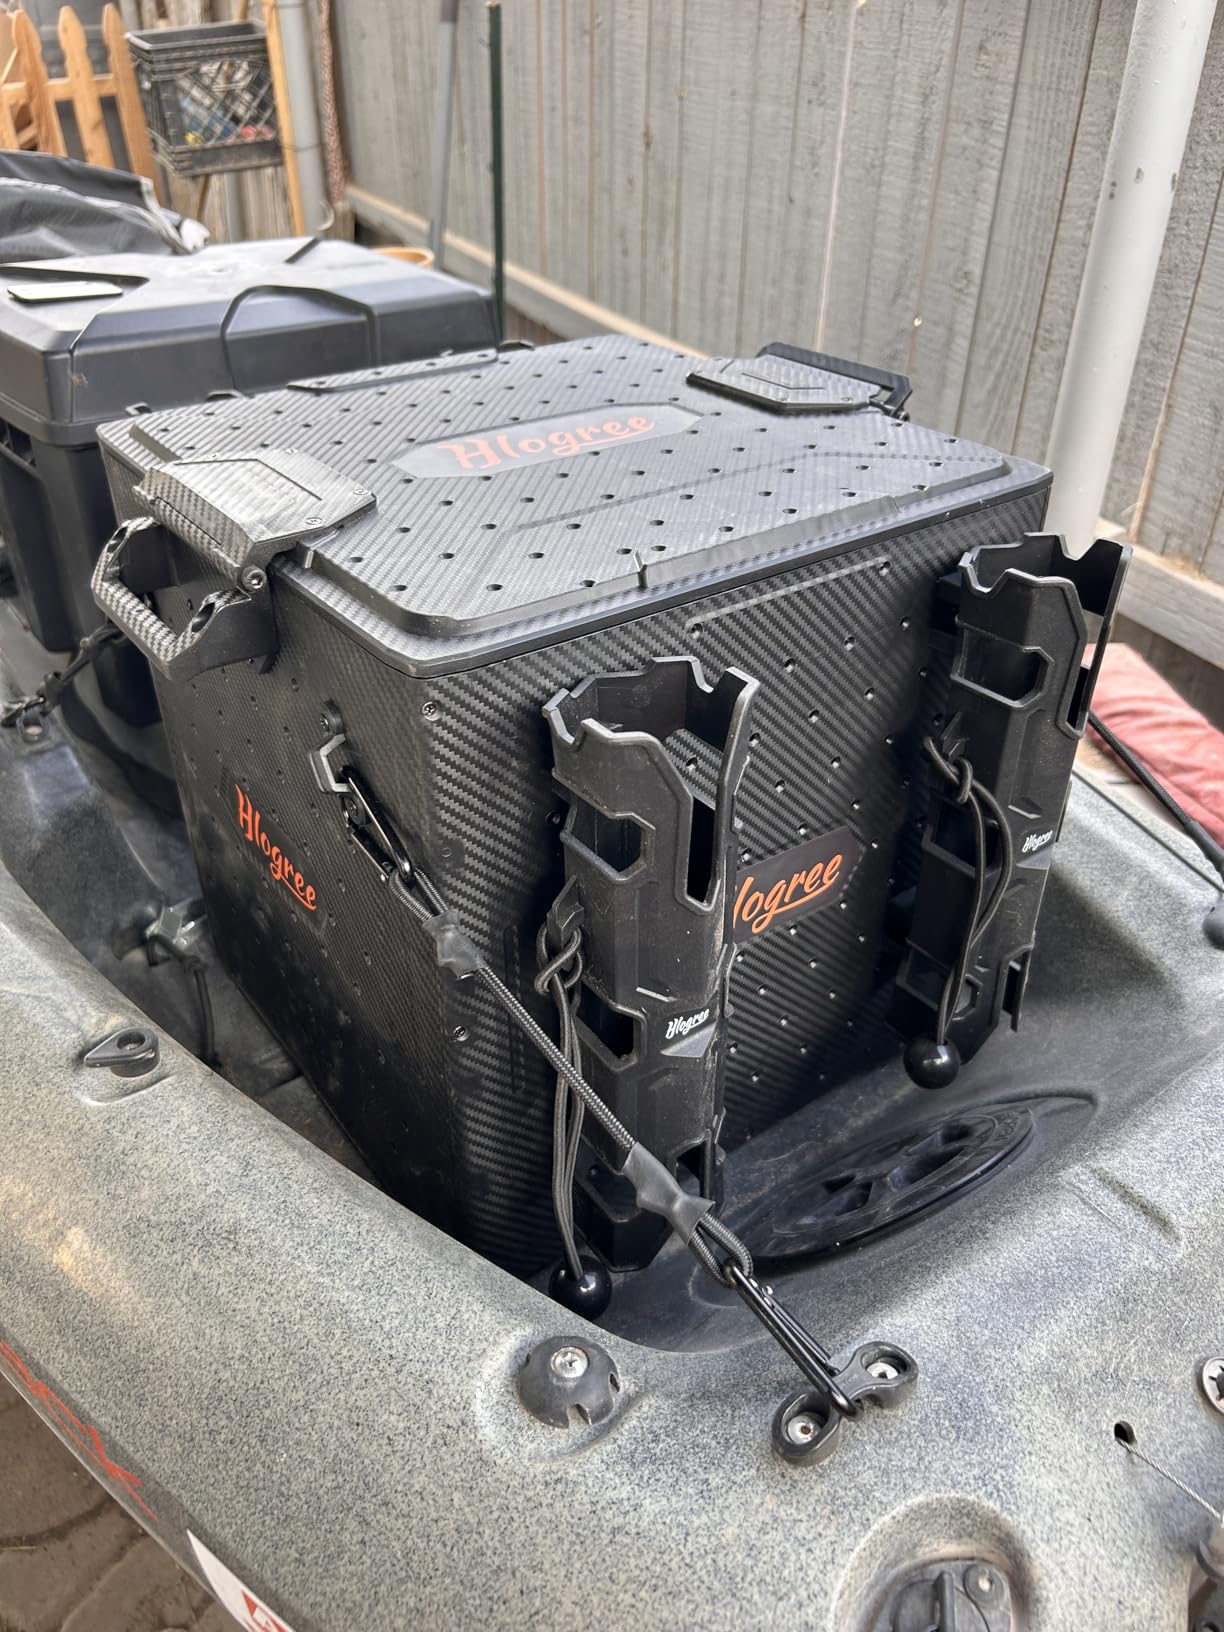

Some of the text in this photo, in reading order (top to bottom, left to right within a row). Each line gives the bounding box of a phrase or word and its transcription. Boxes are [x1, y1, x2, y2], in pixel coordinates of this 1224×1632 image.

[437, 416, 655, 469] Hlogree
[235, 784, 317, 910] Hlogree
[732, 854, 843, 934] logree
[665, 1009, 710, 1040] Hlogree
